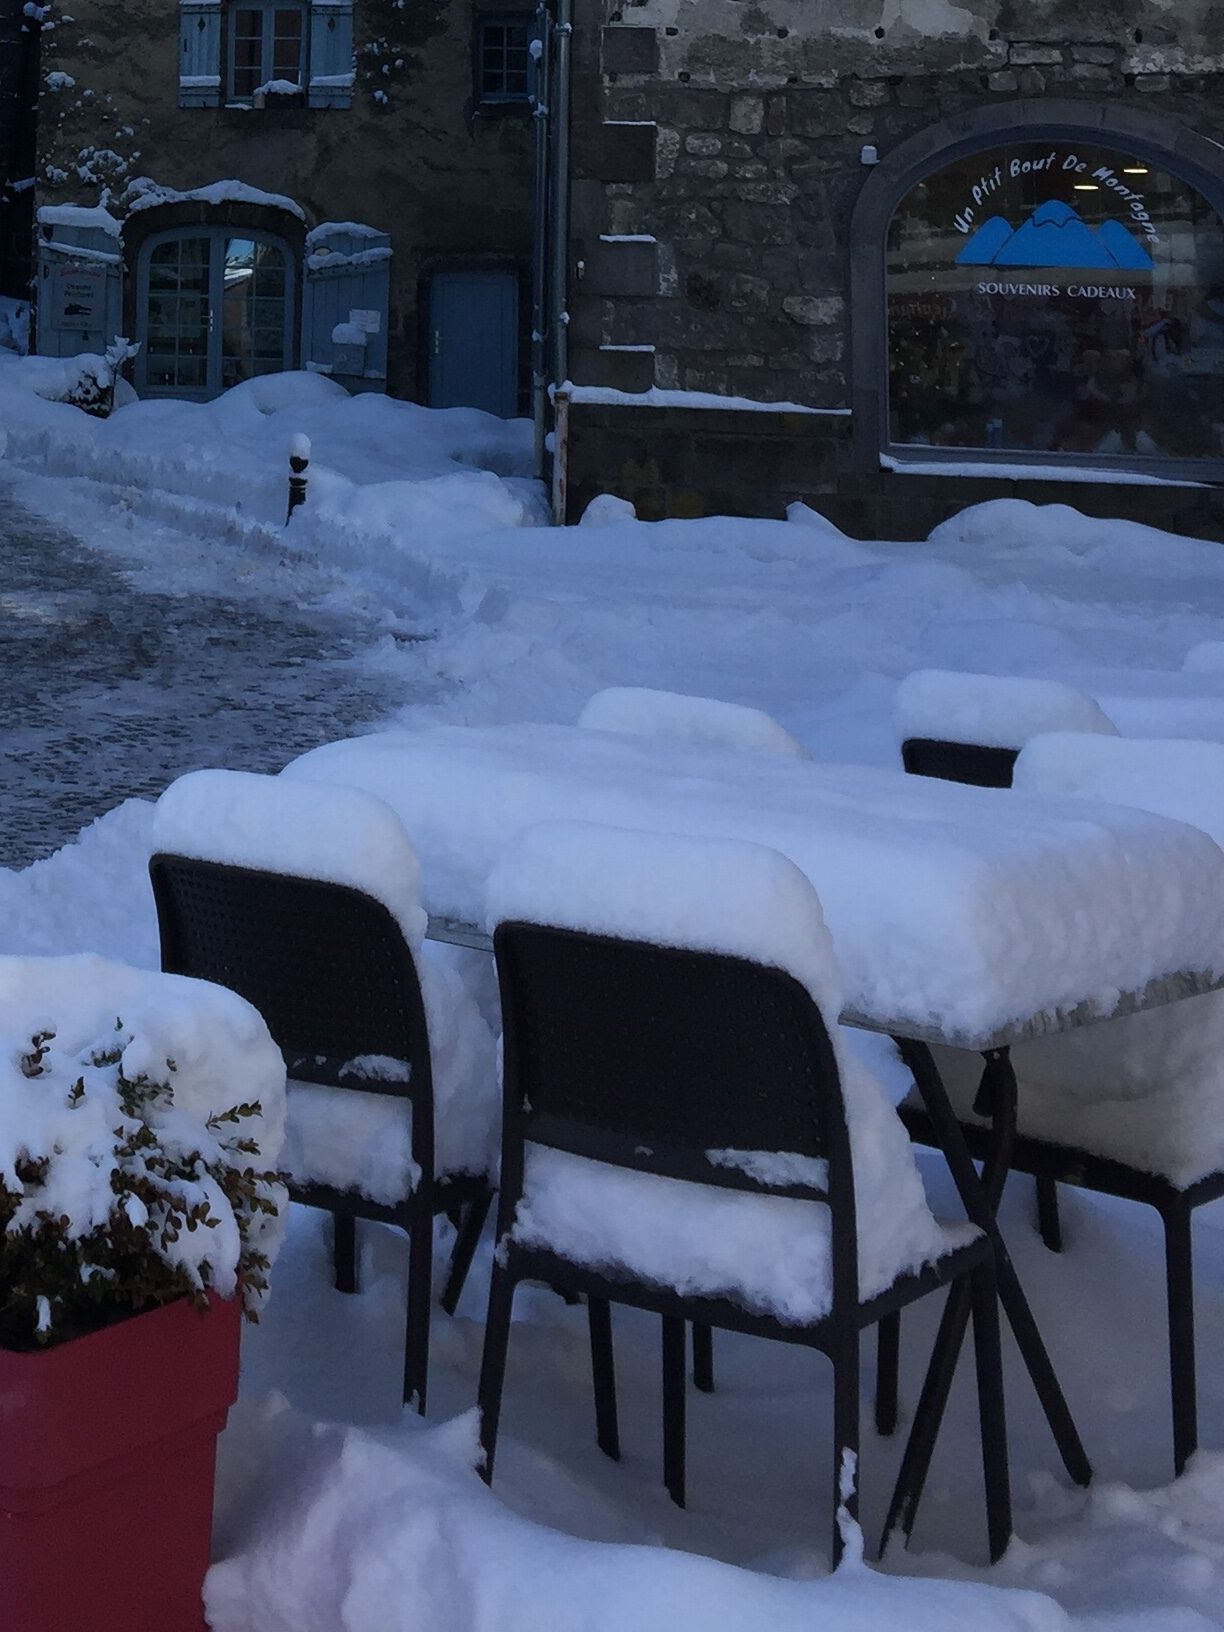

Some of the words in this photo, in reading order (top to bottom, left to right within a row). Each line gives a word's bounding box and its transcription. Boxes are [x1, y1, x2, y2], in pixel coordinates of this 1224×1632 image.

[954, 206, 975, 234] Un
[971, 166, 1001, 206] Ptit
[1010, 152, 1057, 178] Bout
[1062, 154, 1087, 173] De
[1092, 166, 1160, 243] Montagne
[978, 281, 1060, 297] SOUVENIRS
[1067, 285, 1137, 300] CADEAUX
